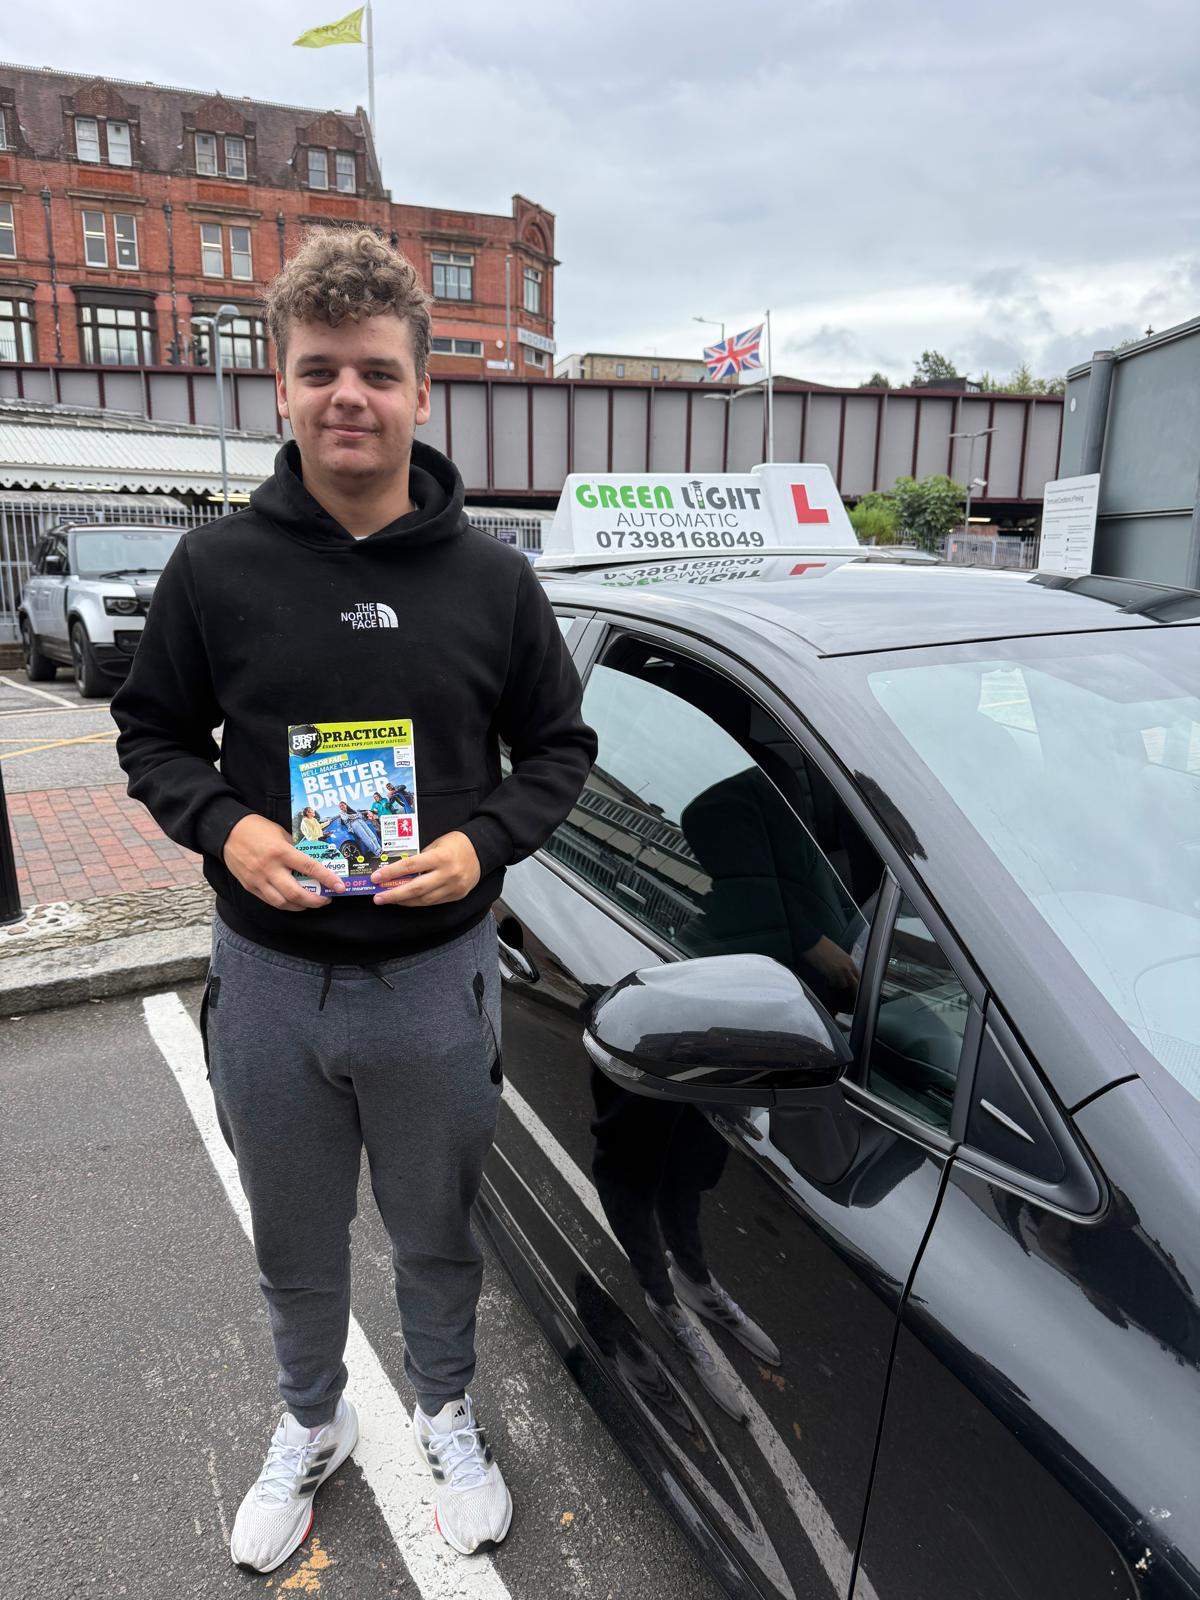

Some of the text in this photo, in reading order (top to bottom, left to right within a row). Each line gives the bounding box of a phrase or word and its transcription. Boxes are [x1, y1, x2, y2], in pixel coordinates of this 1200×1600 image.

[575, 481, 761, 510] GREEN LIGHT
[789, 484, 830, 524] L
[617, 513, 738, 528] AUTOMATIC
[596, 531, 764, 548] 07398168049
[355, 603, 375, 611] THE
[341, 611, 377, 621] NORTH
[352, 620, 378, 629] FACE
[292, 733, 317, 742] FIRST
[322, 726, 407, 742] PRACTICAL
[293, 740, 312, 750] CAR
[301, 767, 319, 777] WE'LL
[319, 764, 339, 772] MAKE
[339, 760, 353, 769] YOU
[303, 760, 387, 794] BETTER
[307, 776, 390, 810] DRIVER
